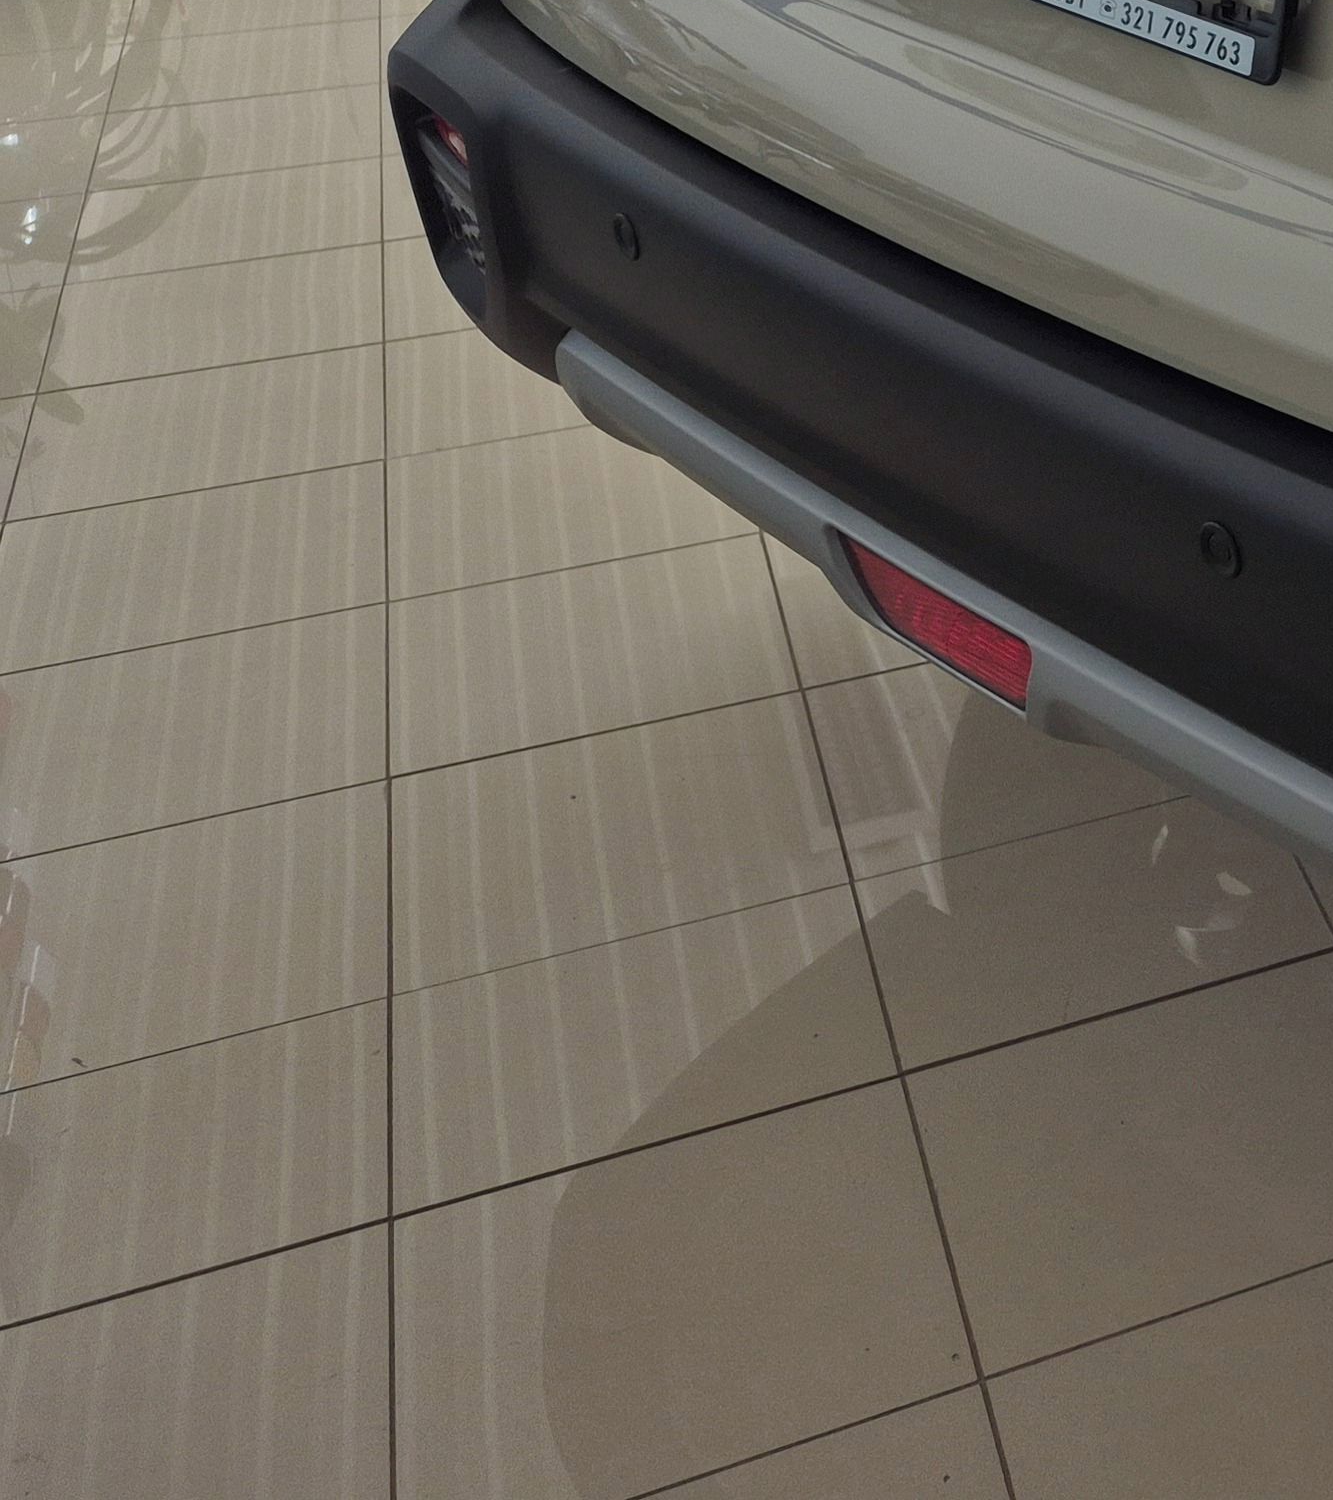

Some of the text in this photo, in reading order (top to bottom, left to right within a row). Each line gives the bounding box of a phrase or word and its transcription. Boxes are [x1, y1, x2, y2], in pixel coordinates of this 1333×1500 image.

[1120, 2, 1154, 34] 321
[1161, 16, 1198, 50] 795
[1204, 31, 1241, 66] 763
